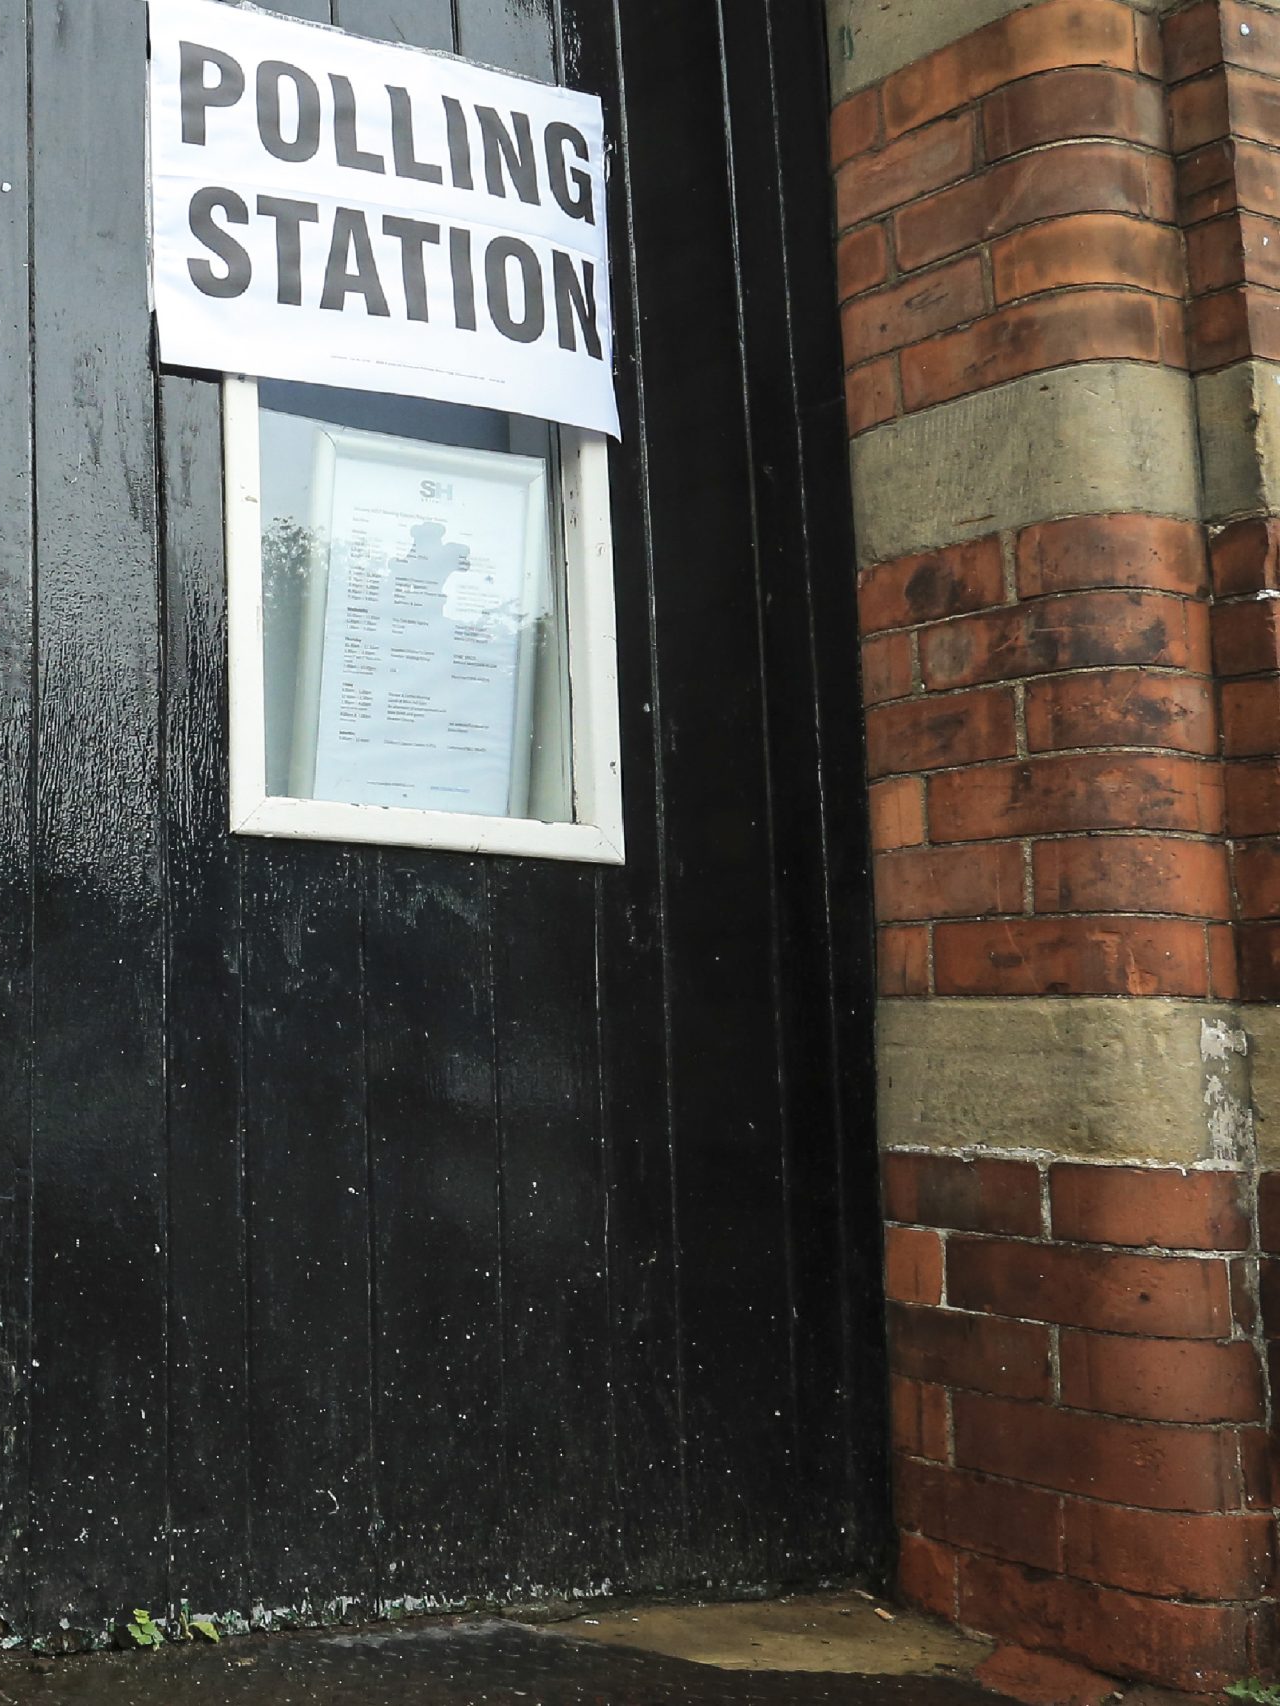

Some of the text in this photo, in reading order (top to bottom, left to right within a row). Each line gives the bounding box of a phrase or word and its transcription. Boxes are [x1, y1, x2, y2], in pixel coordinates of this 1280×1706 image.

[179, 40, 596, 226] POLLING
[187, 186, 604, 361] STATION
[419, 480, 454, 501] SH
